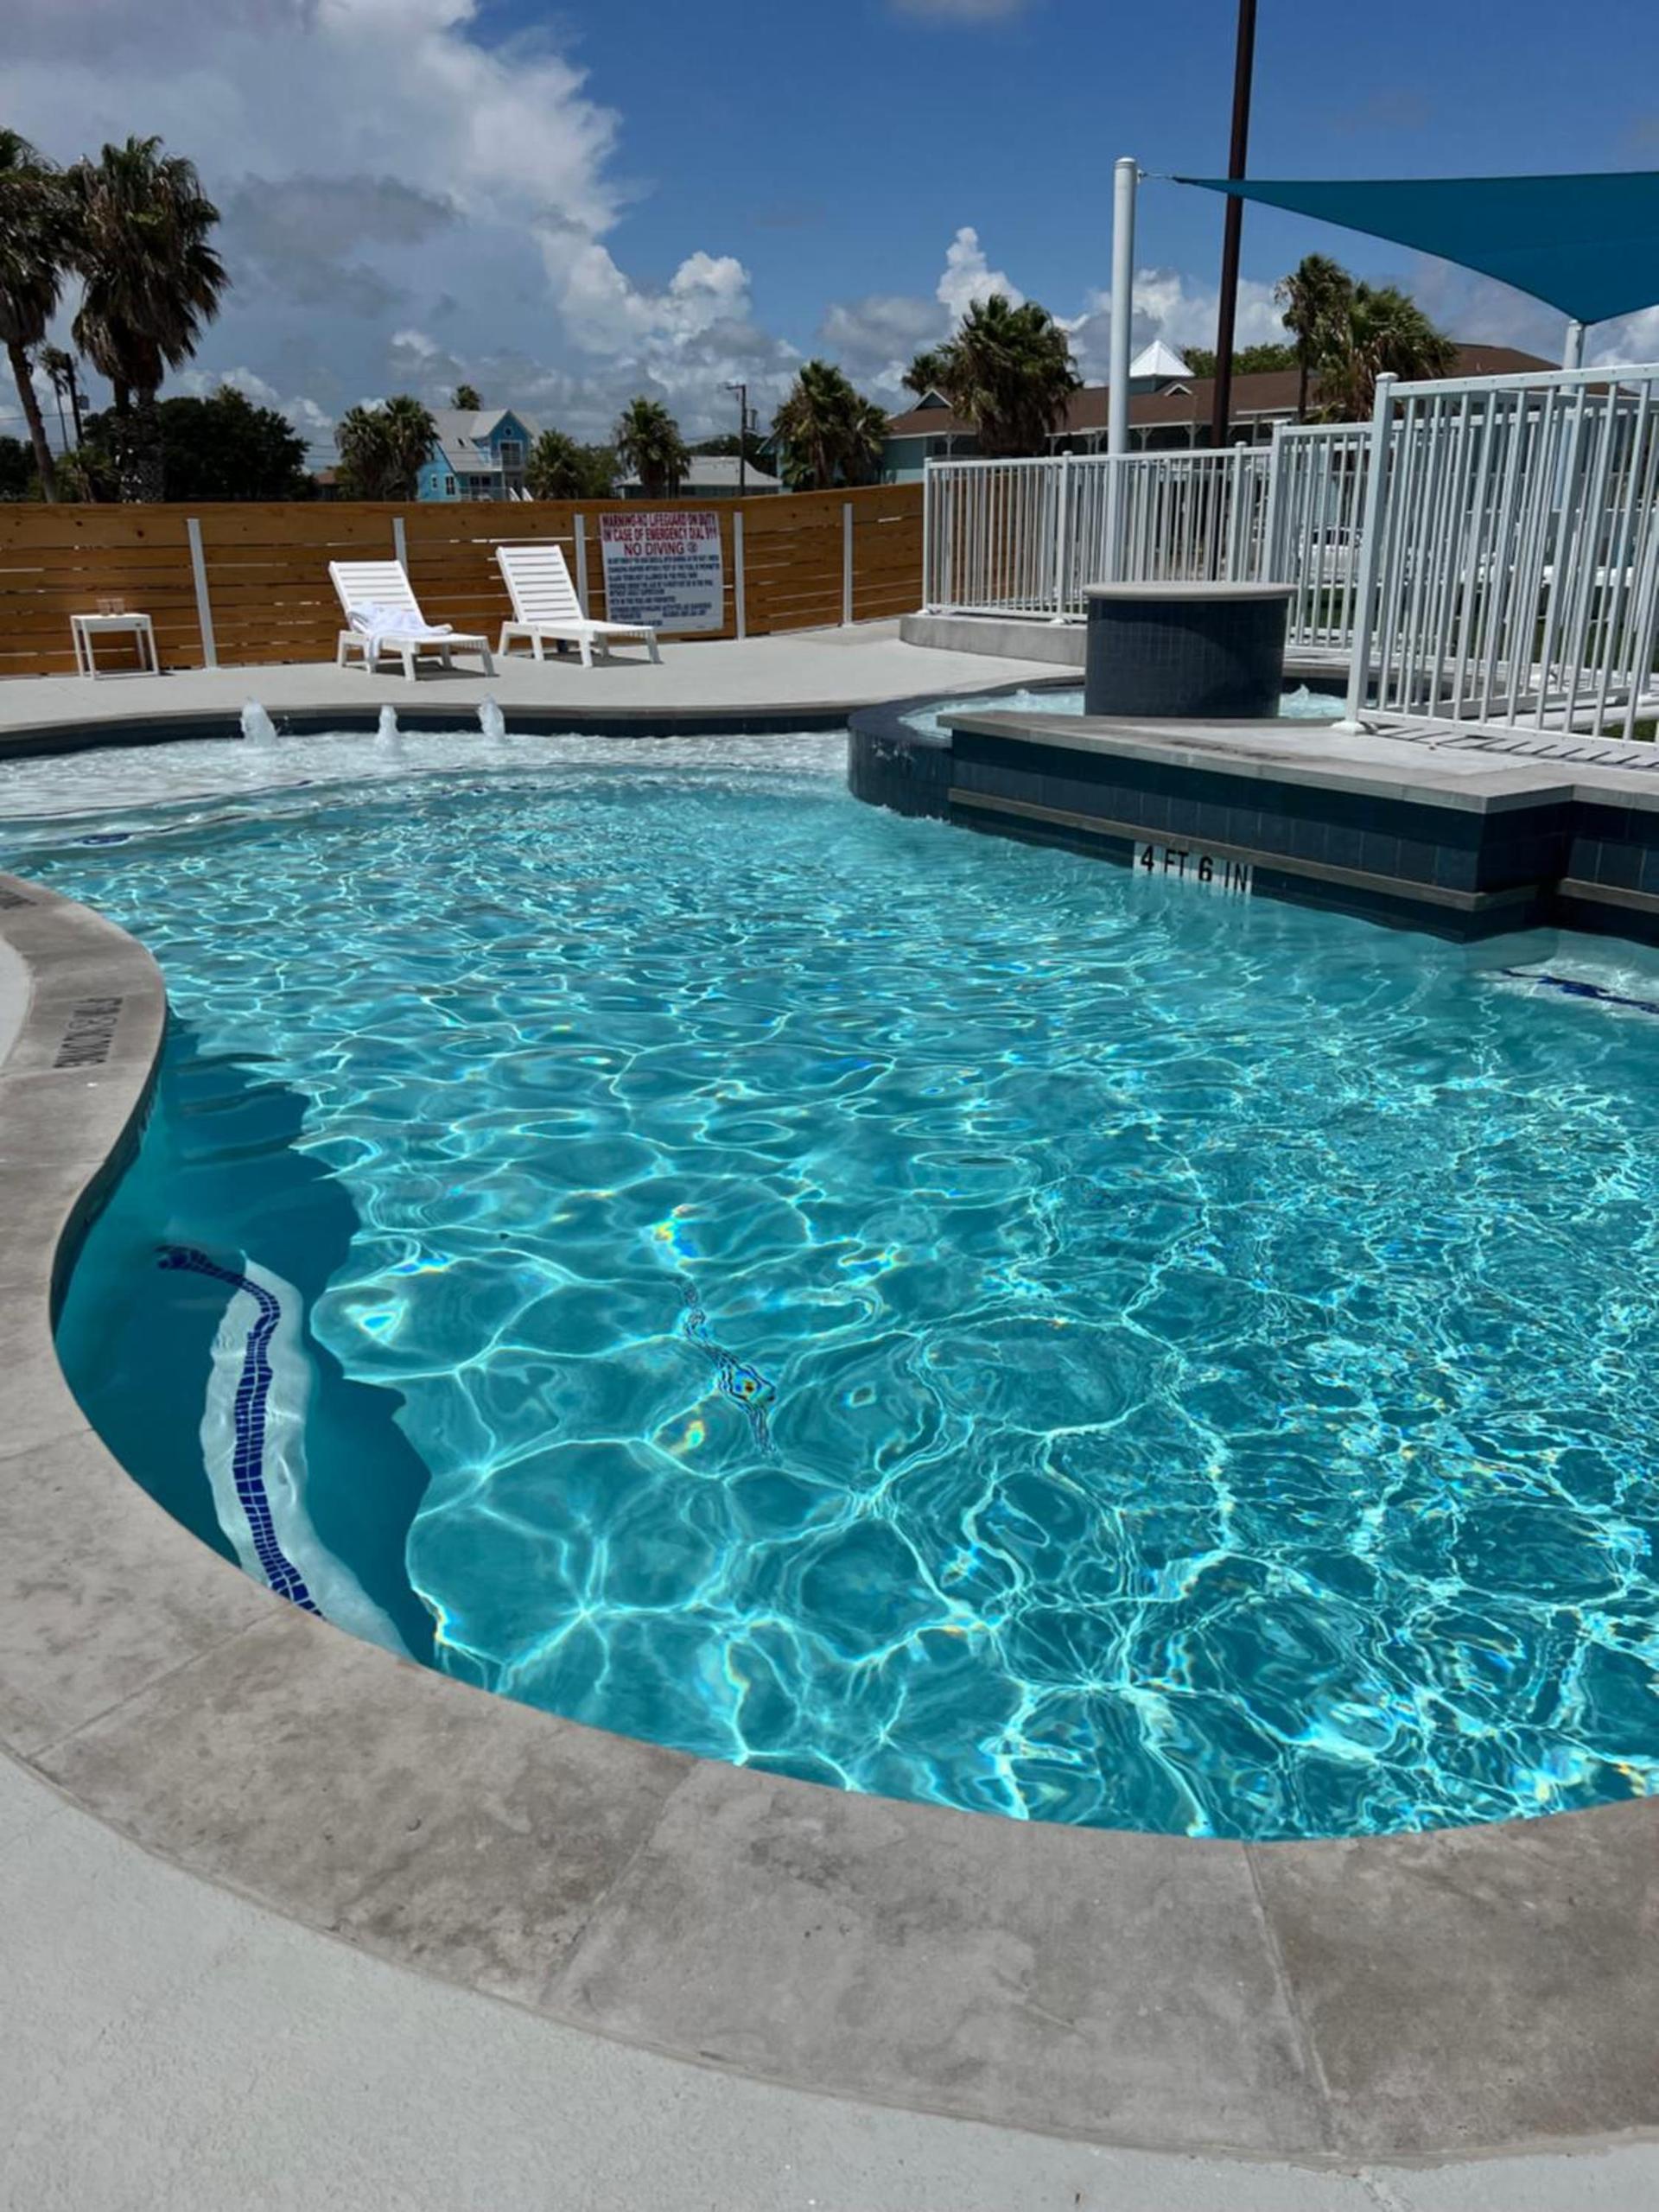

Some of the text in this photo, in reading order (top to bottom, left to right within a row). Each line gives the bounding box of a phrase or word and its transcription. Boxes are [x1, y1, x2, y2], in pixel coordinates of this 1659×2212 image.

[614, 528, 632, 541] CASE
[634, 528, 643, 541] OF
[645, 527, 687, 540] EMERGENCY
[624, 542, 684, 556] NO DIVING
[1141, 845, 1248, 893] 4 FT 6 IN
